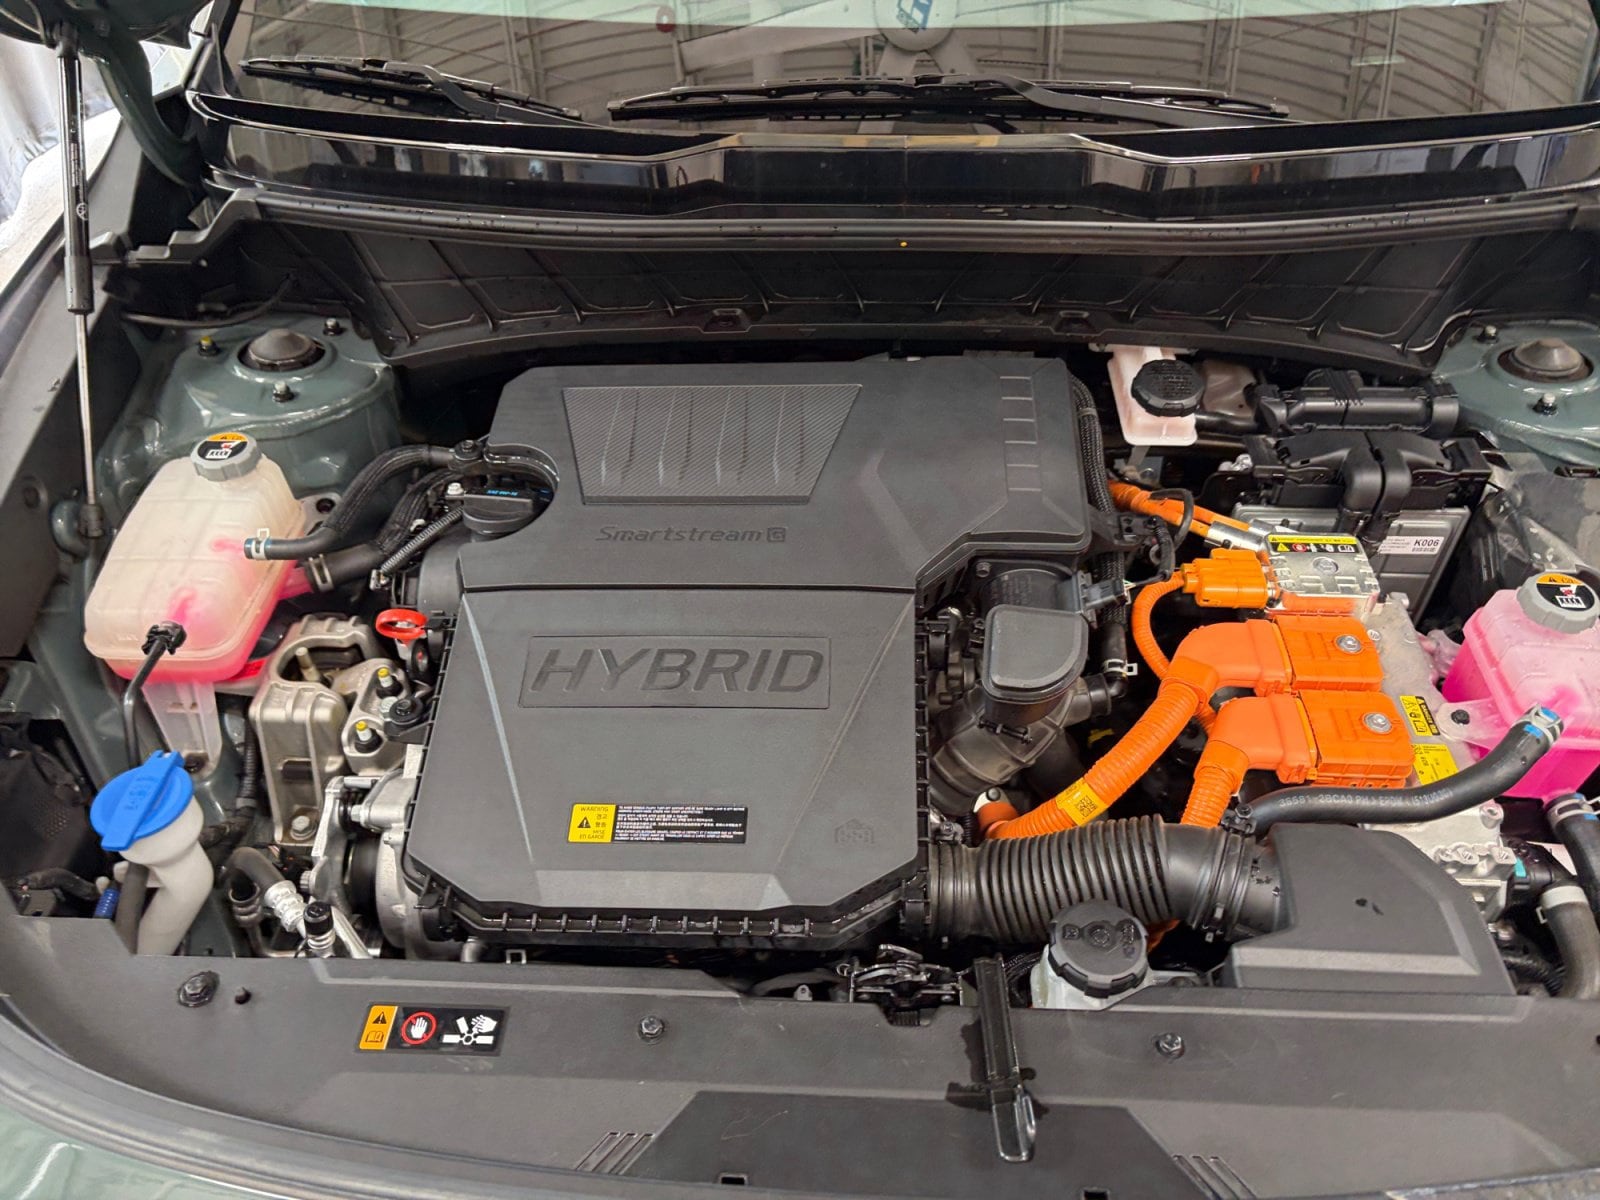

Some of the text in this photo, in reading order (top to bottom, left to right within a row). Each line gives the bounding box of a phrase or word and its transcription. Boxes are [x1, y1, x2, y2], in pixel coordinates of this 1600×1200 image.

[595, 526, 763, 542] Smartstream
[1413, 539, 1440, 547] K006
[528, 647, 824, 692] HYBRID
